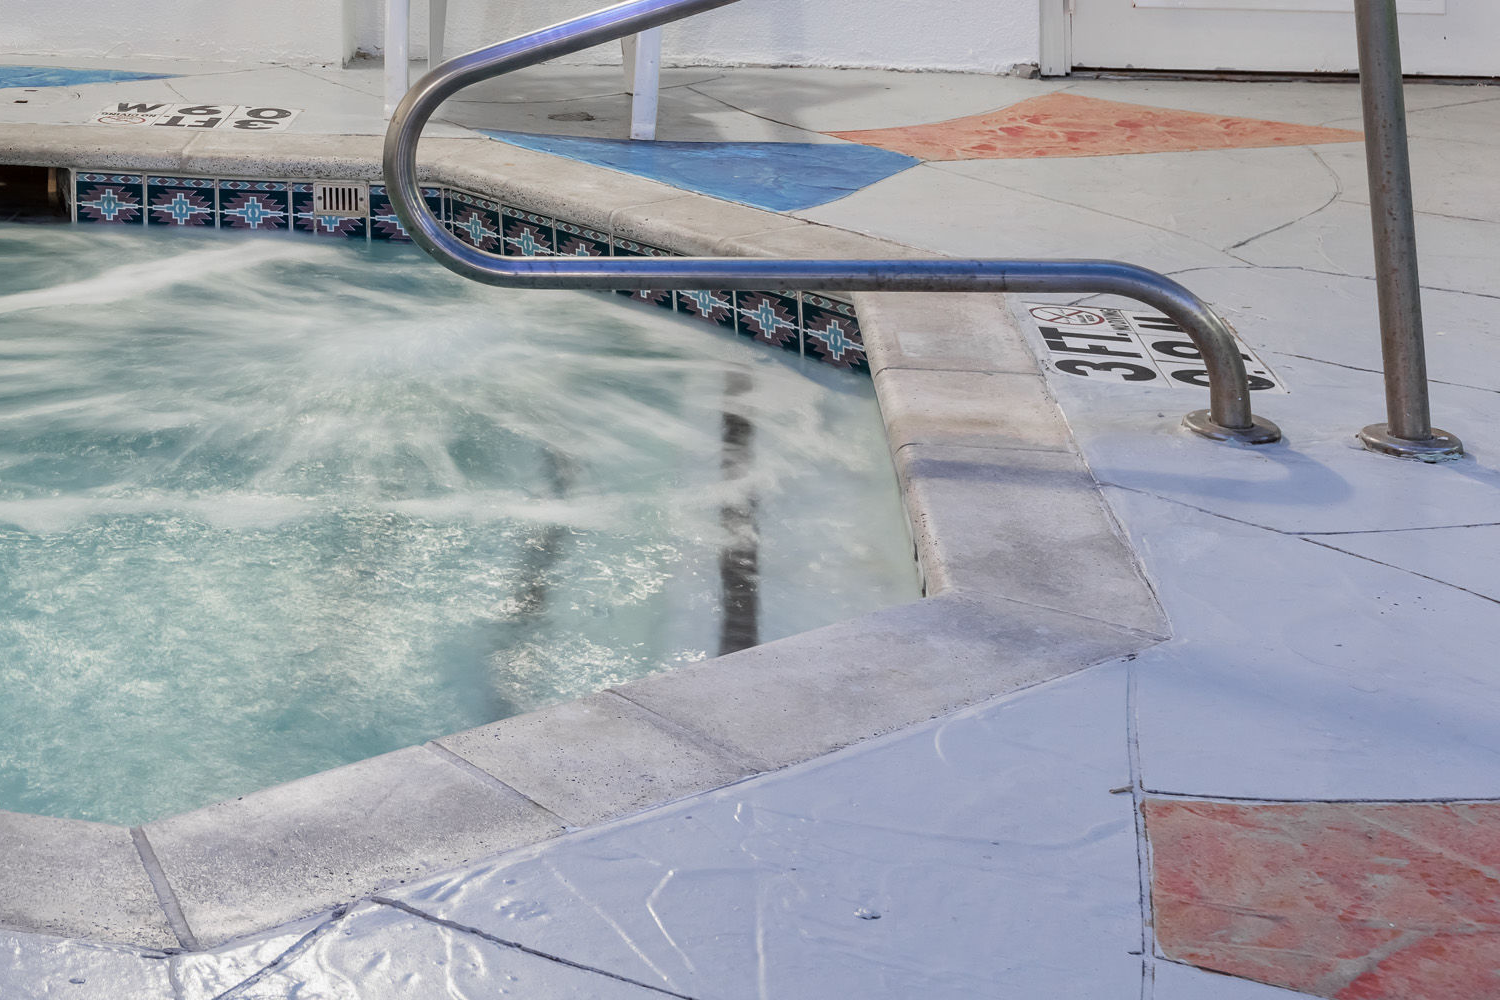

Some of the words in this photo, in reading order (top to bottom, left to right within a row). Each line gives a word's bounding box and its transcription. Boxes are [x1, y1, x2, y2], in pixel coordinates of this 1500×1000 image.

[117, 102, 165, 113] M
[232, 119, 280, 130] 3
[1054, 359, 1157, 382] 3
